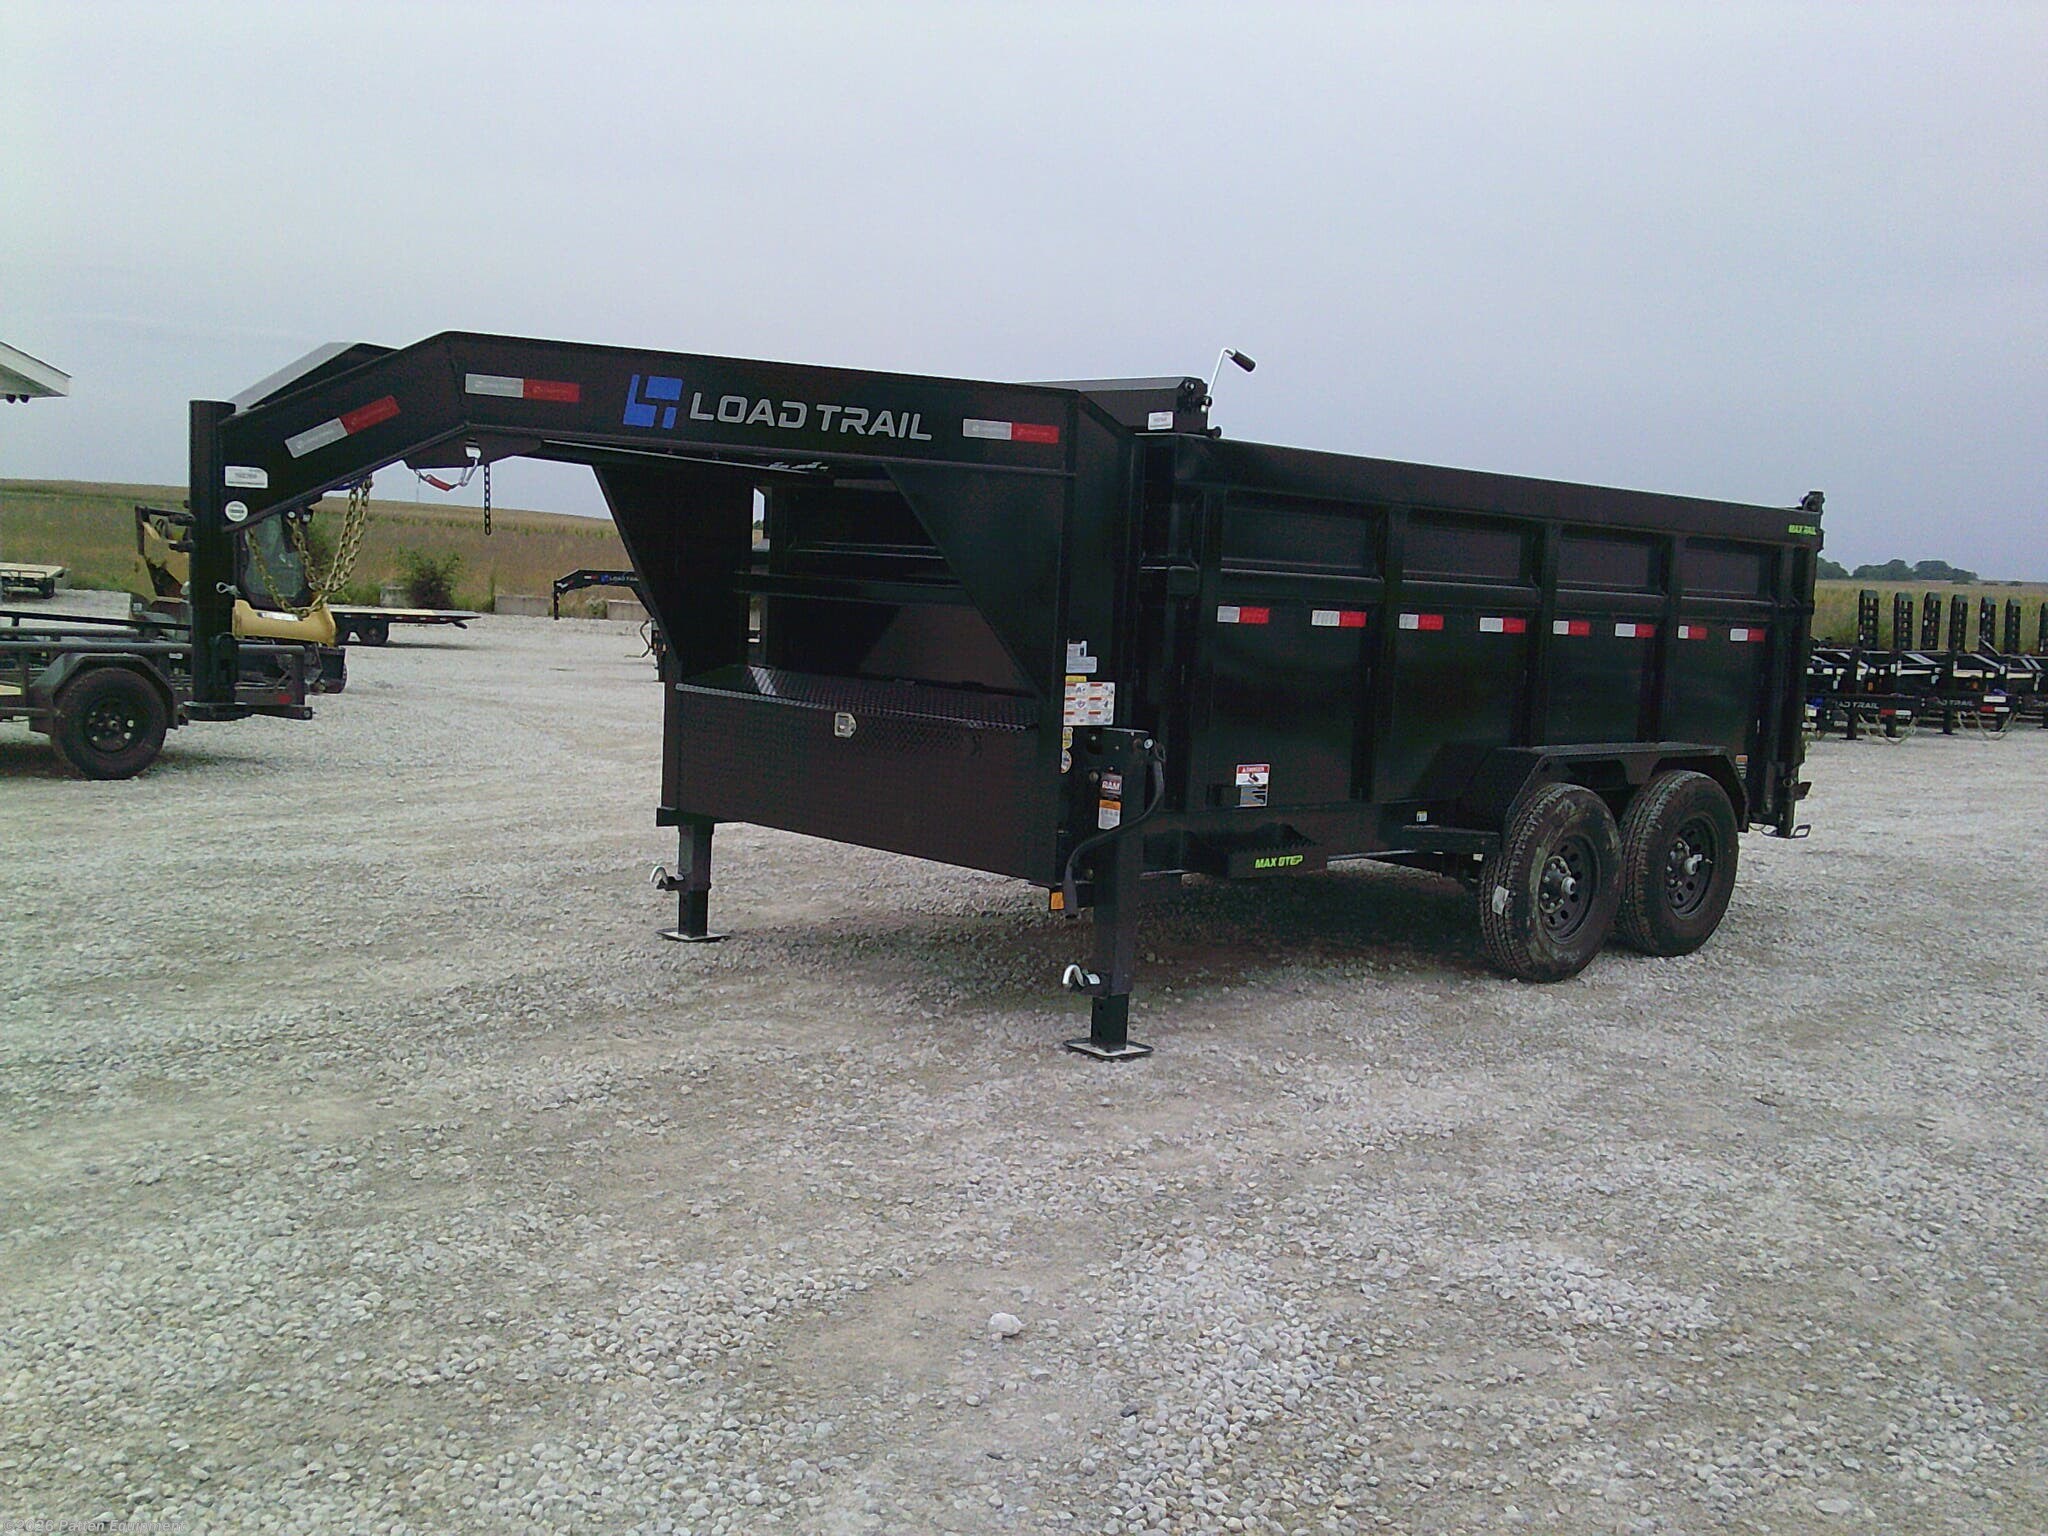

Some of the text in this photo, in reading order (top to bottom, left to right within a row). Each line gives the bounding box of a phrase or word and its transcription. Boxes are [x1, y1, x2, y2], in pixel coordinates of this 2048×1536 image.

[689, 392, 933, 441] LOAD TRAIL
[1255, 858, 1277, 869] MAX
